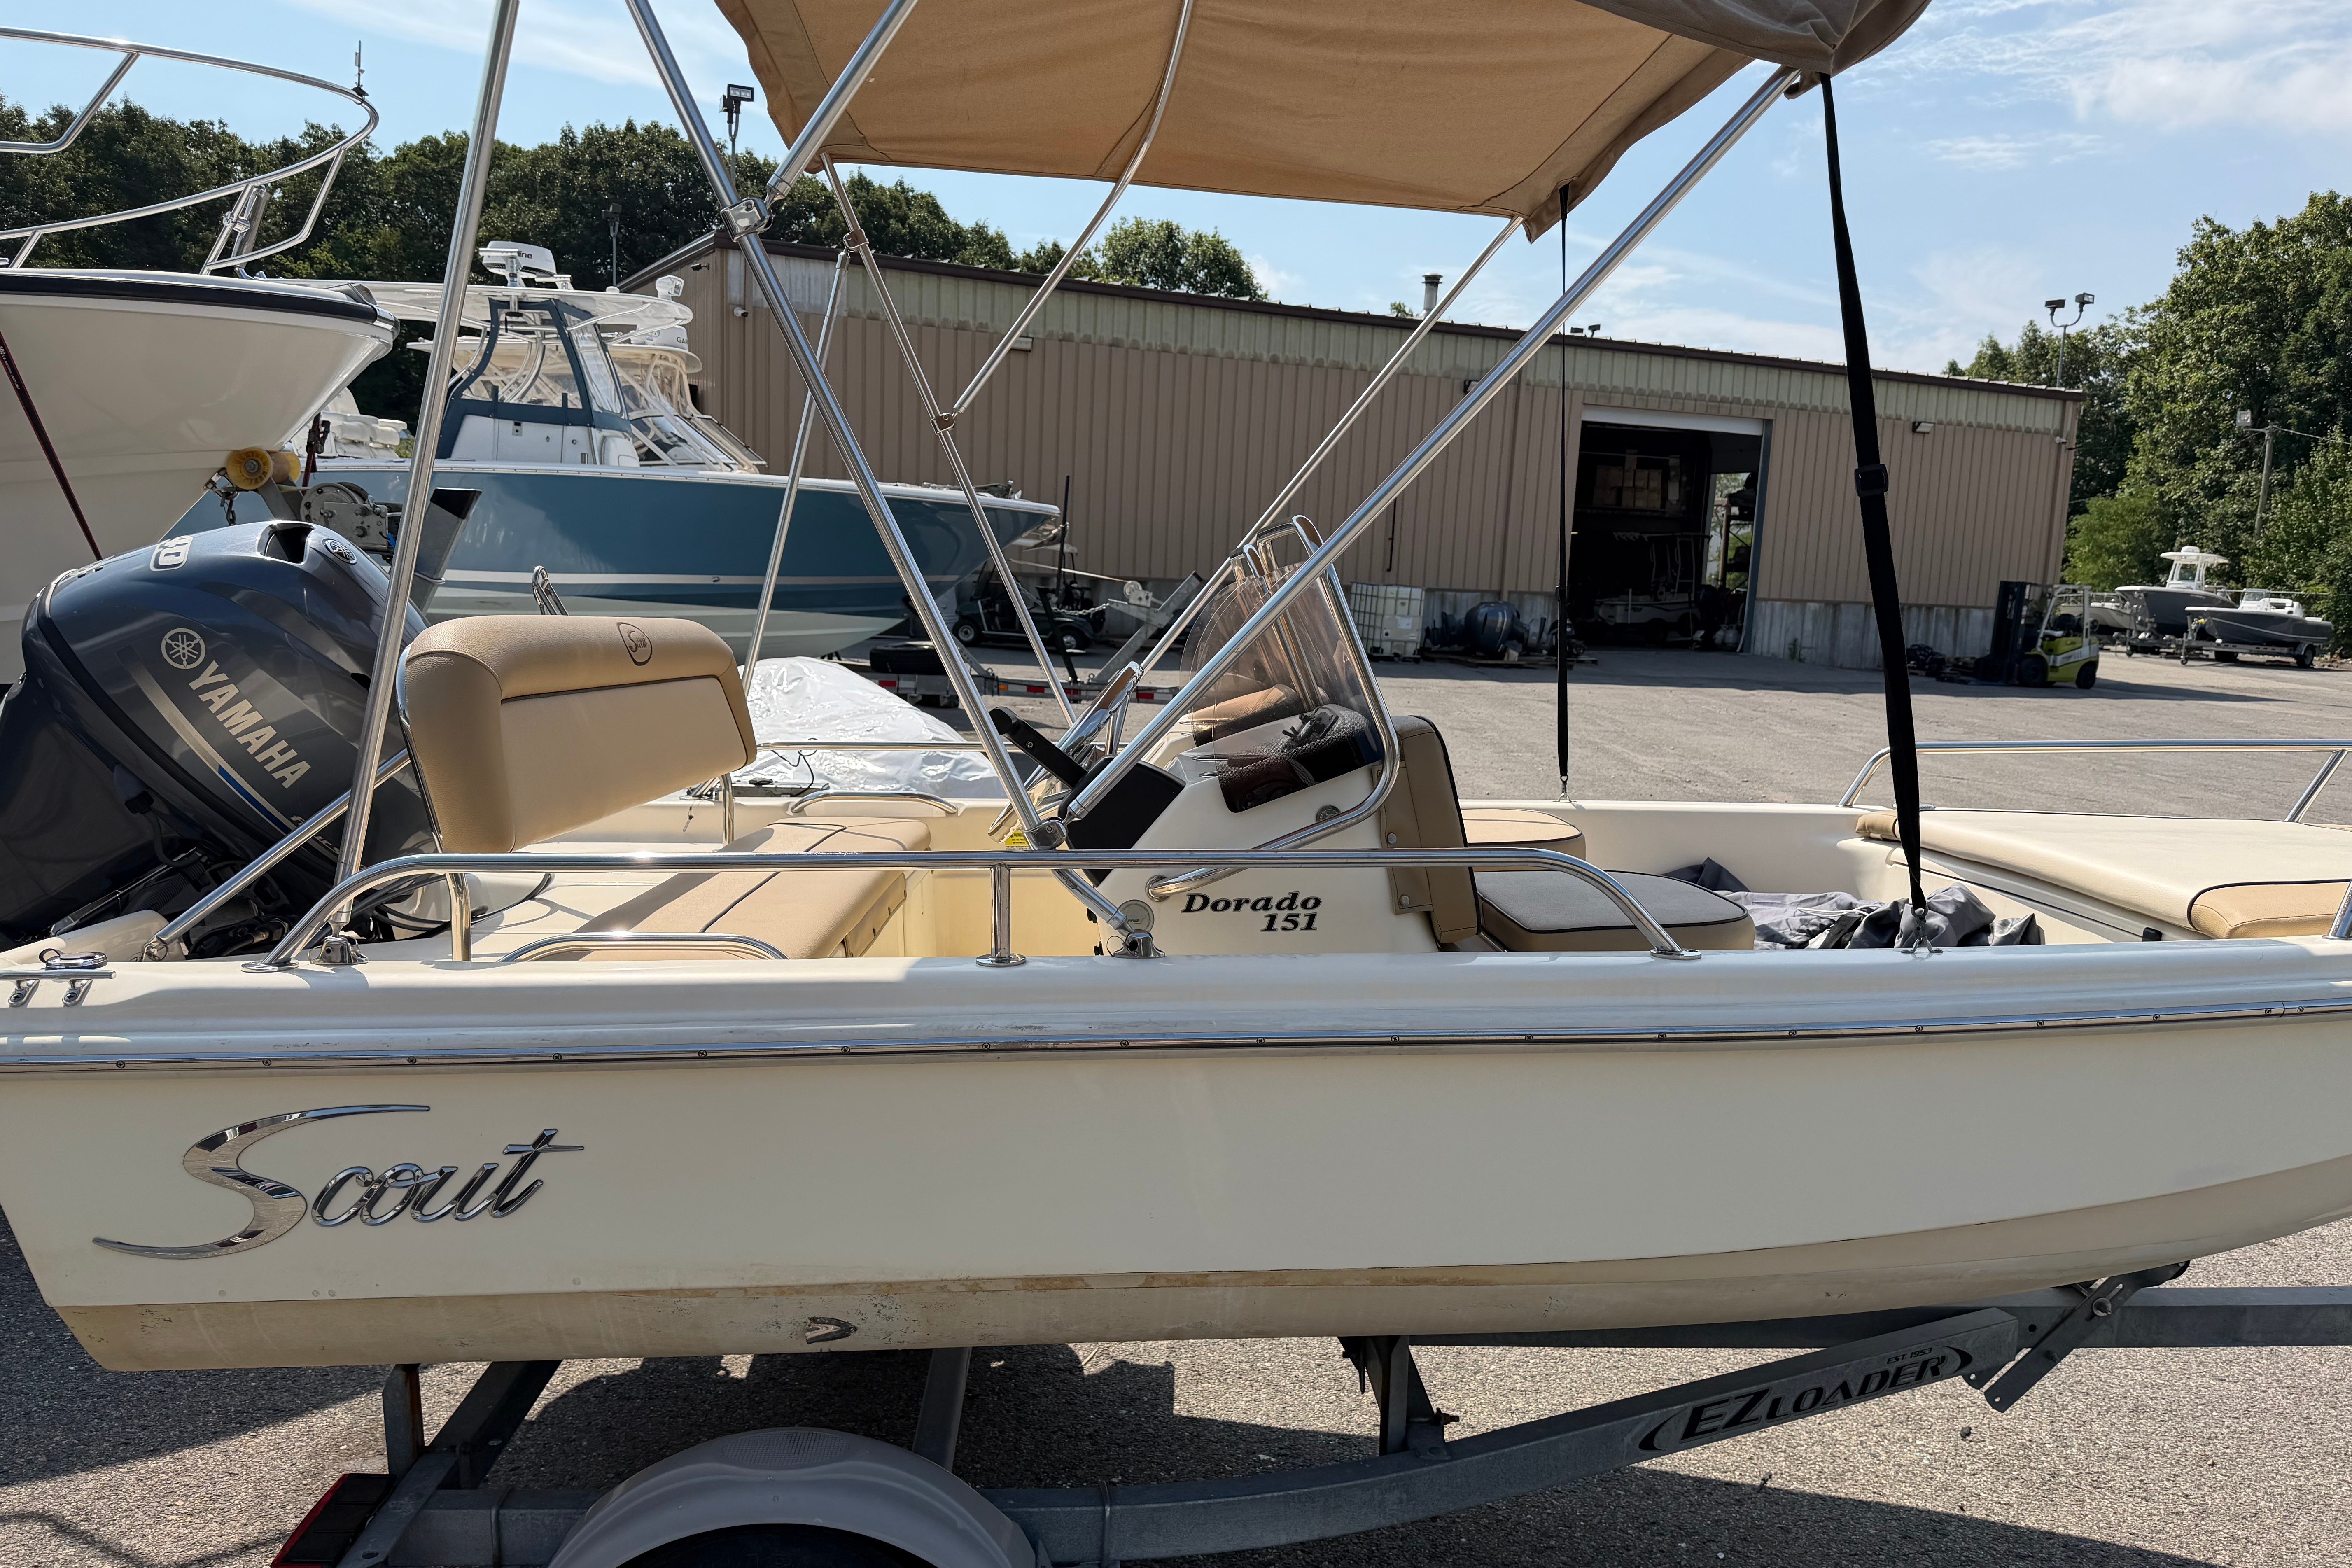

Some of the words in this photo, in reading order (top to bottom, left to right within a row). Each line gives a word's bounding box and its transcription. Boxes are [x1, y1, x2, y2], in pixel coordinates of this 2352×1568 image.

[189, 660, 311, 789] YAMAHA
[1181, 891, 1322, 913] Dorado
[1260, 912, 1317, 931] 151
[91, 1104, 584, 1260] Scout
[1887, 1353, 1907, 1364] EST.
[1910, 1347, 1933, 1358] 1953
